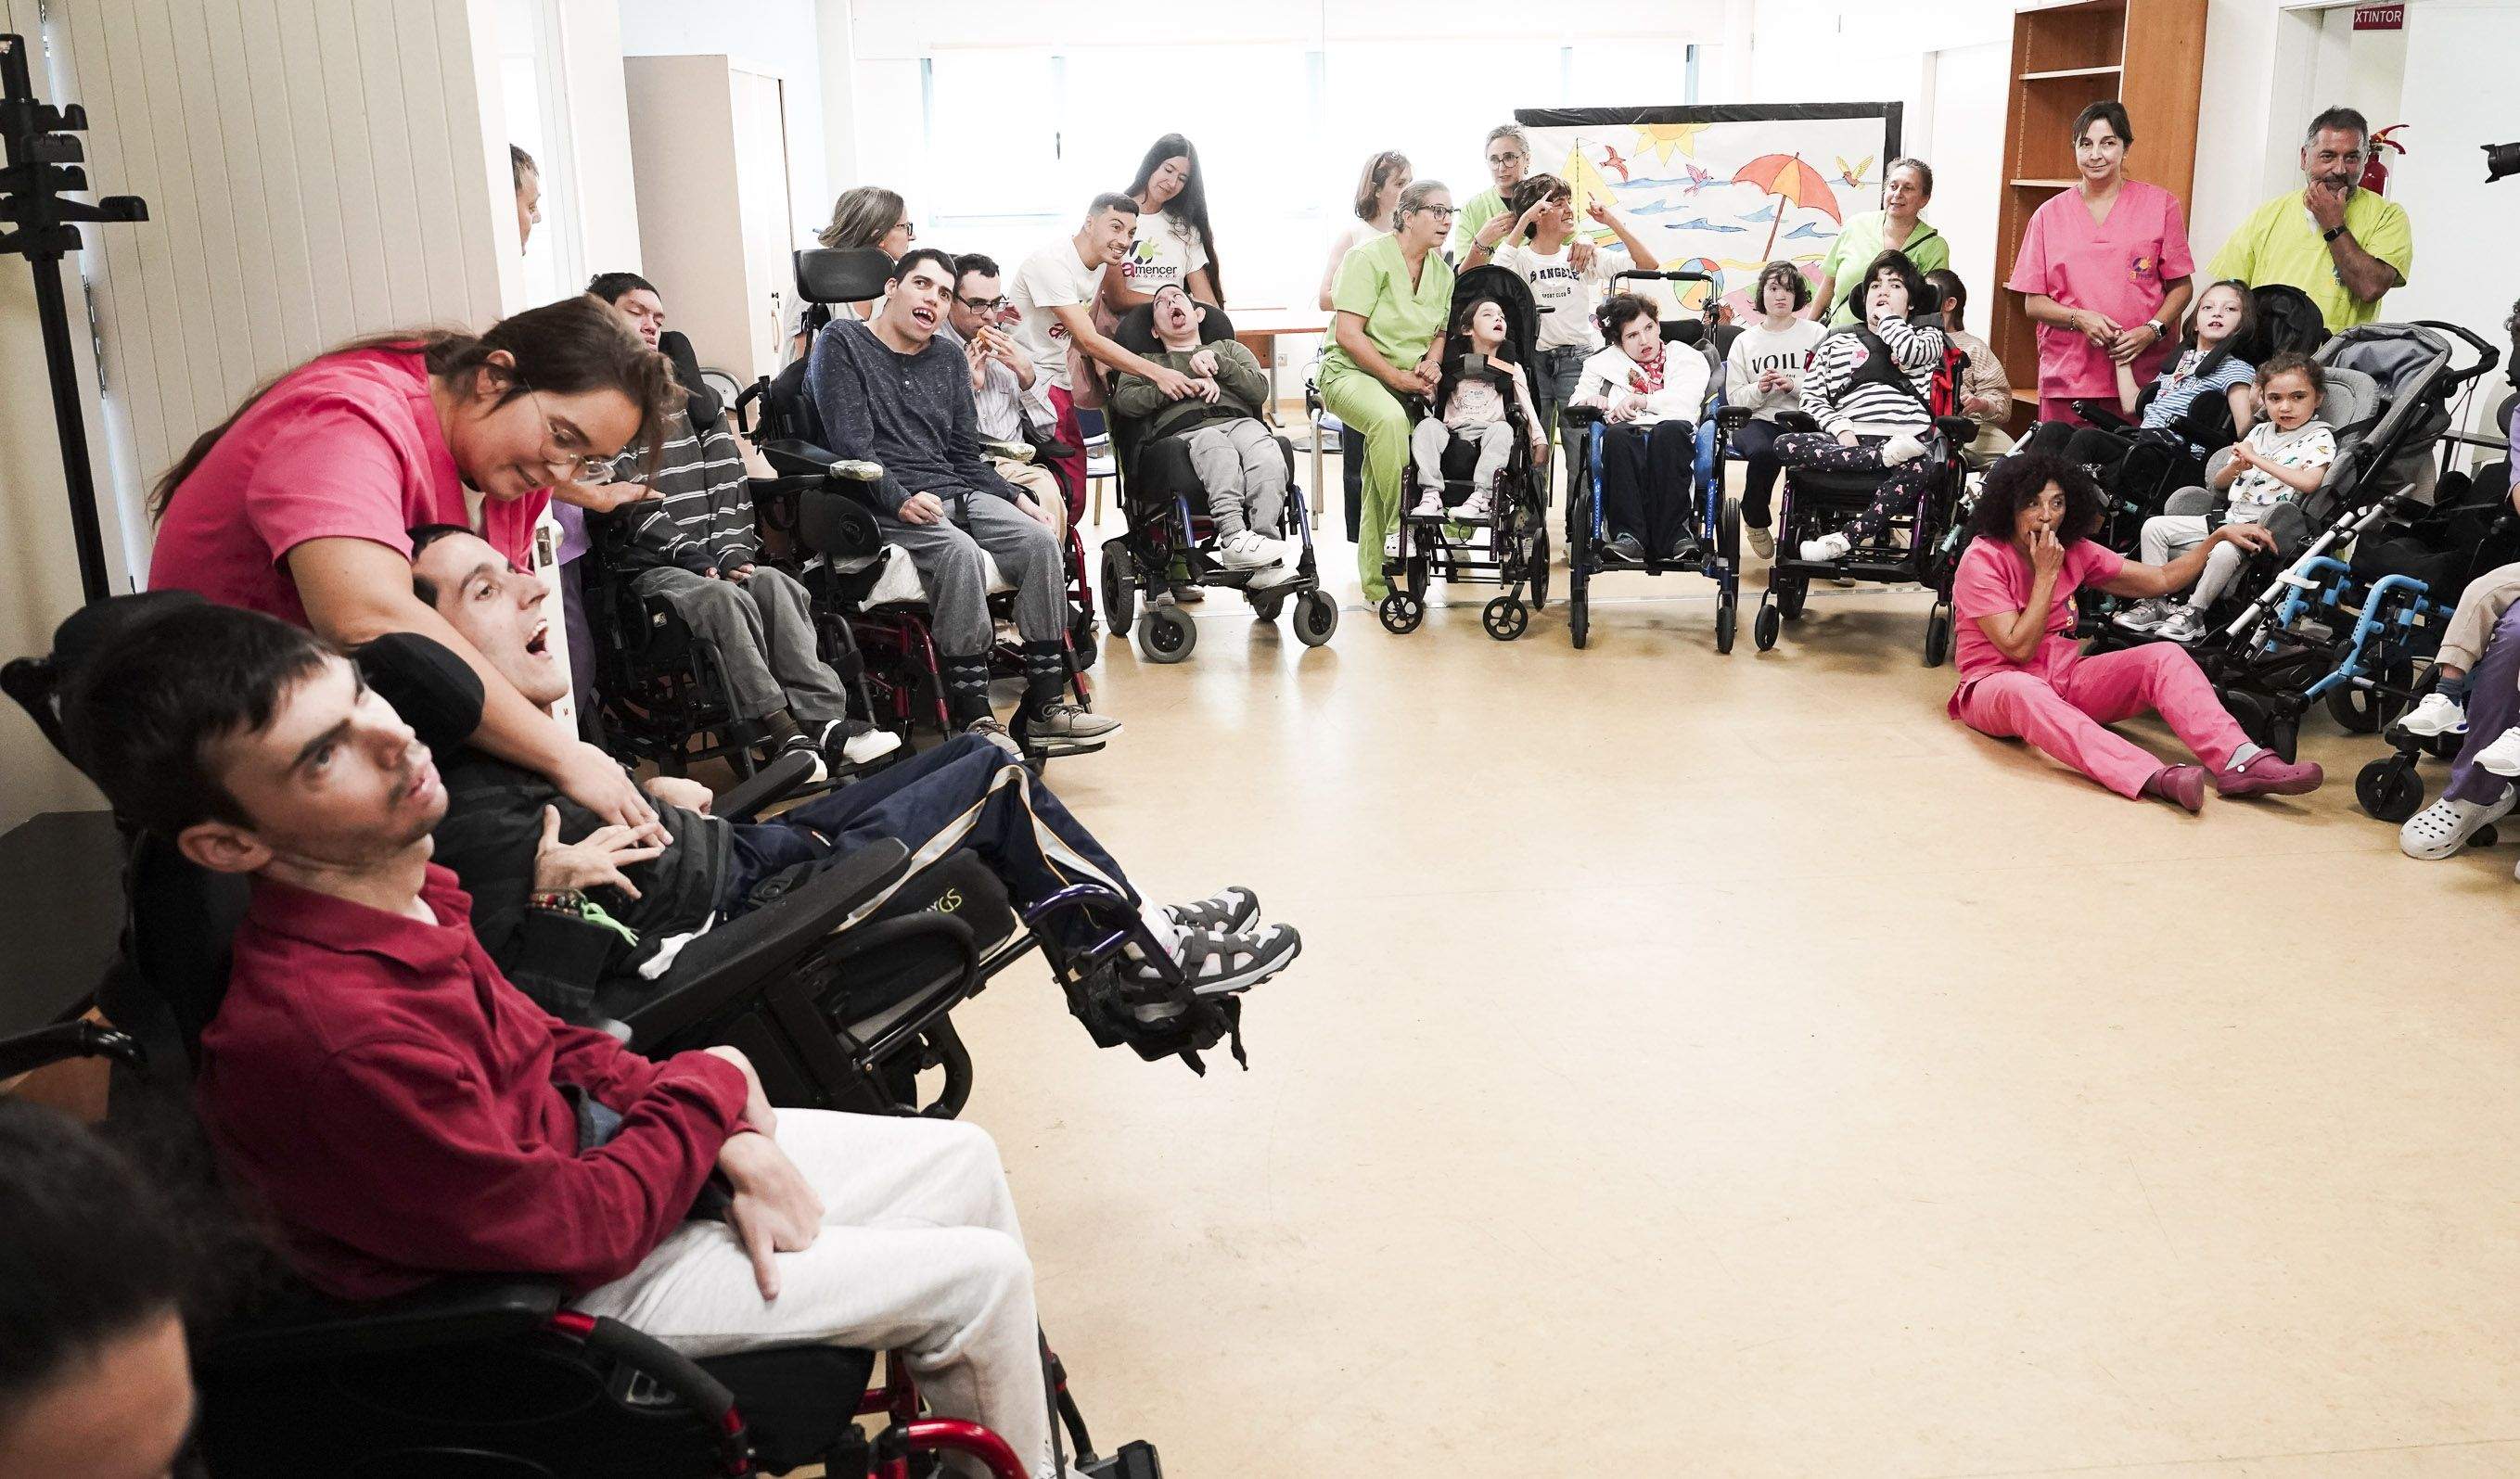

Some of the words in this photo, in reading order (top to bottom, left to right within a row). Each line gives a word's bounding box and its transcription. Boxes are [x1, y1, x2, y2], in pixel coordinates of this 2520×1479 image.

[2355, 10, 2402, 23] XTINTOR
[1121, 261, 1178, 278] amencer
[1540, 267, 1580, 281] ANGELE
